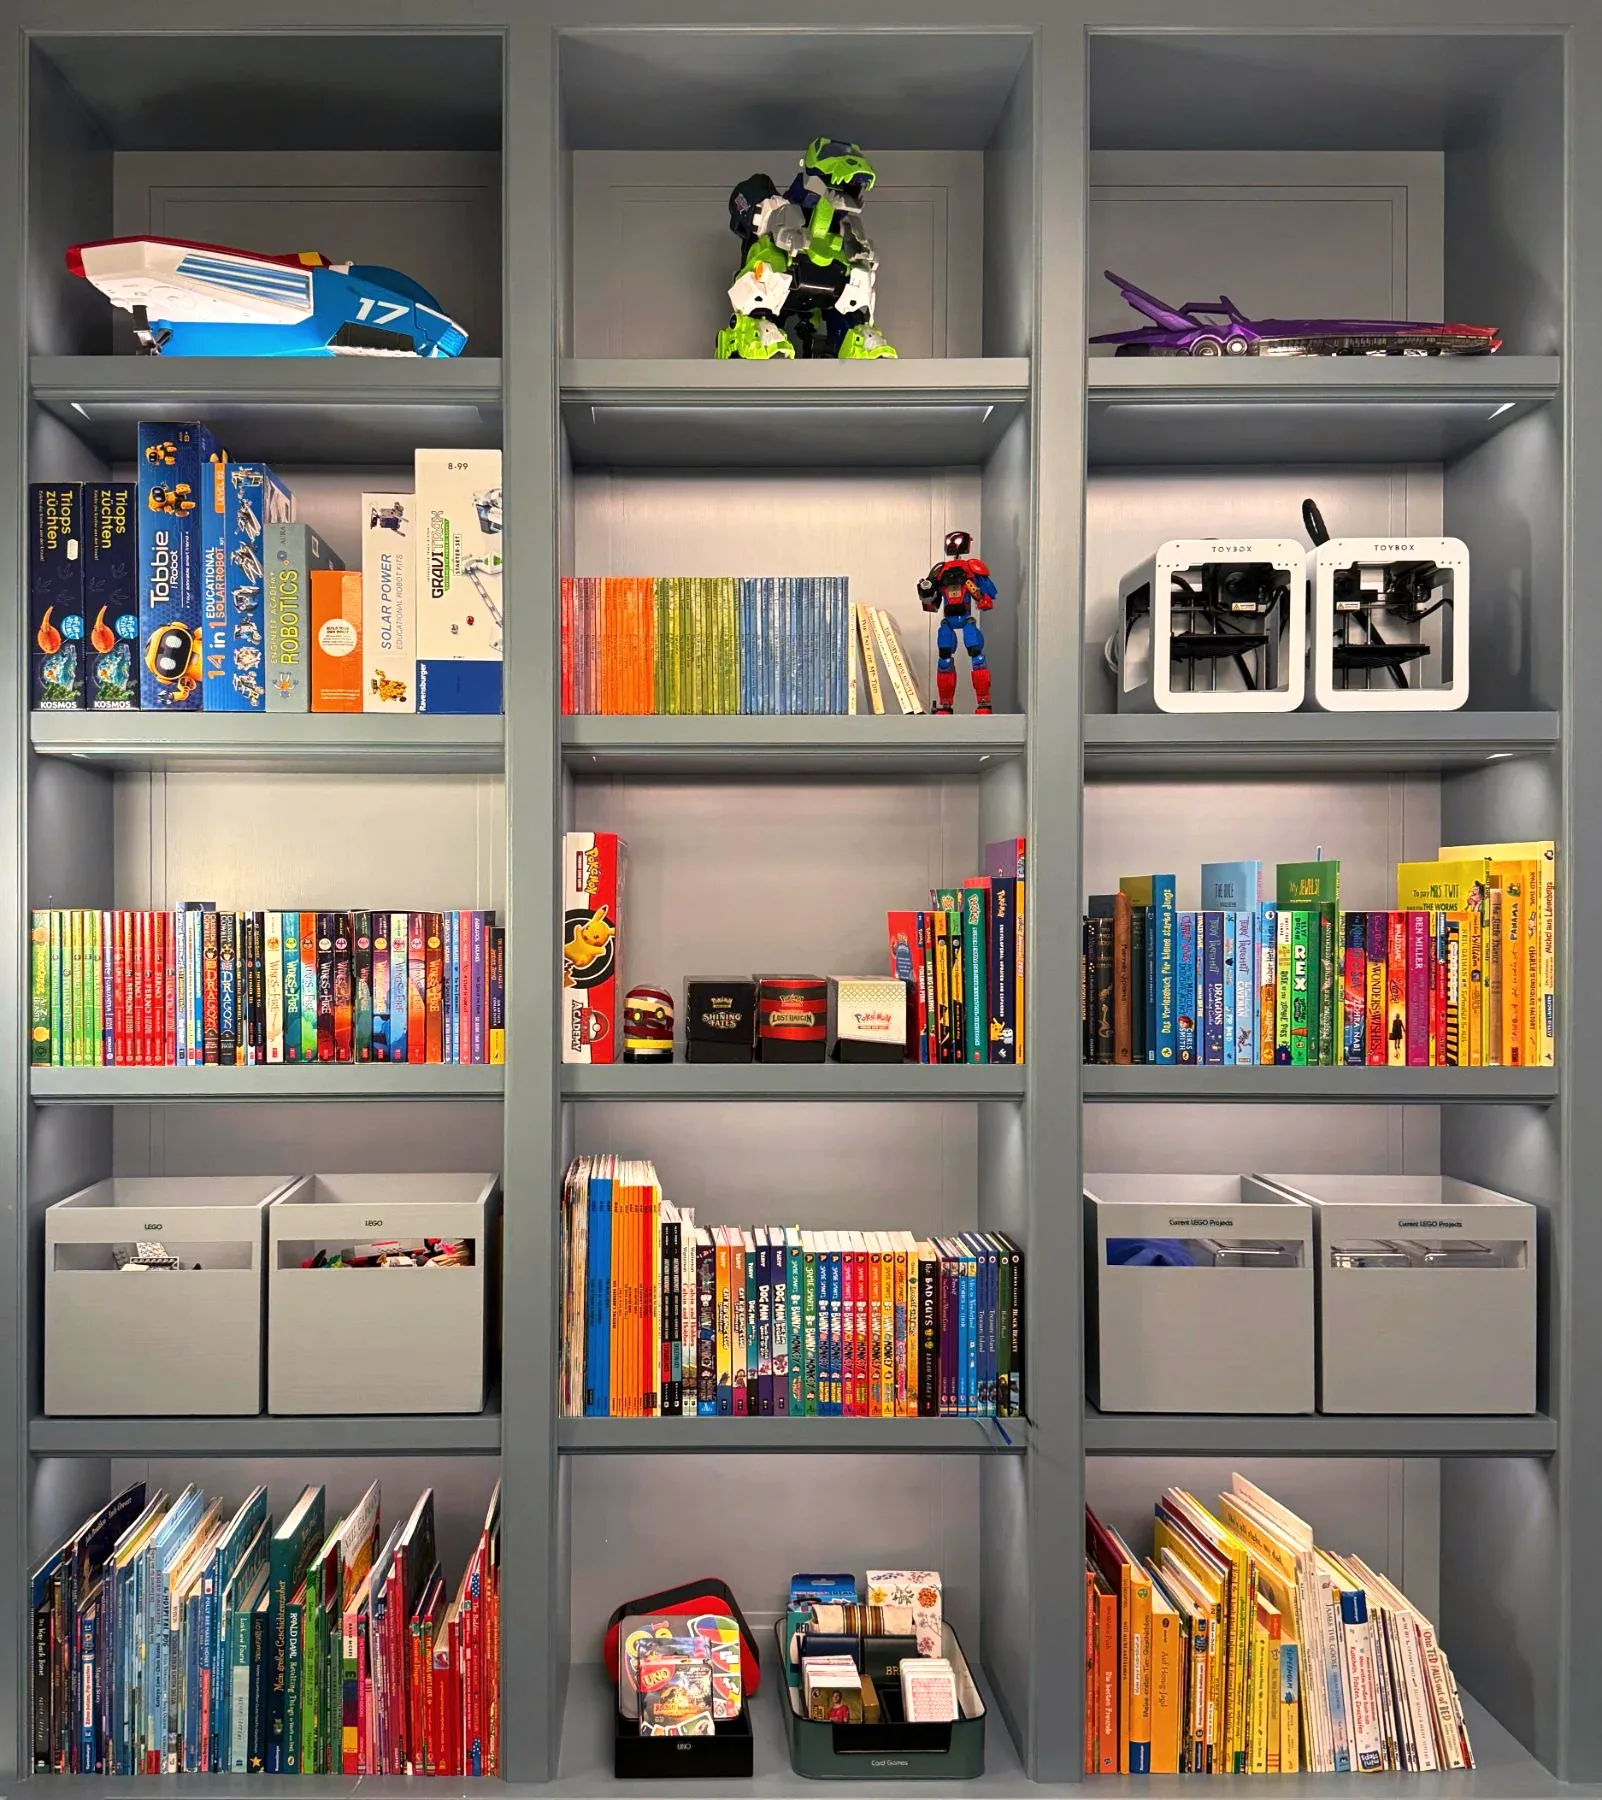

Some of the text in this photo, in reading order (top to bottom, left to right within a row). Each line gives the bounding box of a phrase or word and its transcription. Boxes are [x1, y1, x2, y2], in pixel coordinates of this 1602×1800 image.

[354, 296, 410, 326] 17
[46, 490, 58, 549] züchten
[61, 490, 72, 534] Triops
[101, 490, 113, 548] züchten
[116, 490, 128, 534] Triops
[151, 531, 170, 608] Tobbie
[206, 547, 216, 618] EDUCATIONAL
[216, 548, 224, 618] SOLAR ROBOT
[279, 570, 299, 664] ROBOTICS
[381, 554, 392, 650] SOLAR POWER
[208, 632, 226, 680] 14 in
[40, 702, 77, 710] KOSMOS
[94, 701, 131, 709] KOSMOS
[1415, 917, 1423, 934] BEN
[1294, 945, 1306, 991] REX
[1415, 937, 1423, 969] MILLER
[1370, 966, 1380, 1010] WONDERS
[572, 1000, 583, 1052] ACADEMY
[1353, 999, 1363, 1027] ZOHRA
[1370, 1014, 1380, 1050] WISHES
[1210, 1219, 1233, 1227] Projects
[1439, 1221, 1462, 1229] Projects
[759, 1285, 769, 1320] DOG MAN
[774, 1284, 786, 1321] DOG MAN
[925, 1278, 933, 1298] BAD
[925, 1299, 933, 1326] GUYS
[238, 1618, 247, 1663] Lost Found
[289, 1613, 298, 1658] ROALD DAHL
[1330, 1644, 1338, 1669] GOOSE
[1427, 1650, 1436, 1663] TED
[1430, 1666, 1441, 1683] FALLS
[643, 1668, 668, 1686] UNO
[1440, 1706, 1451, 1720] BED
